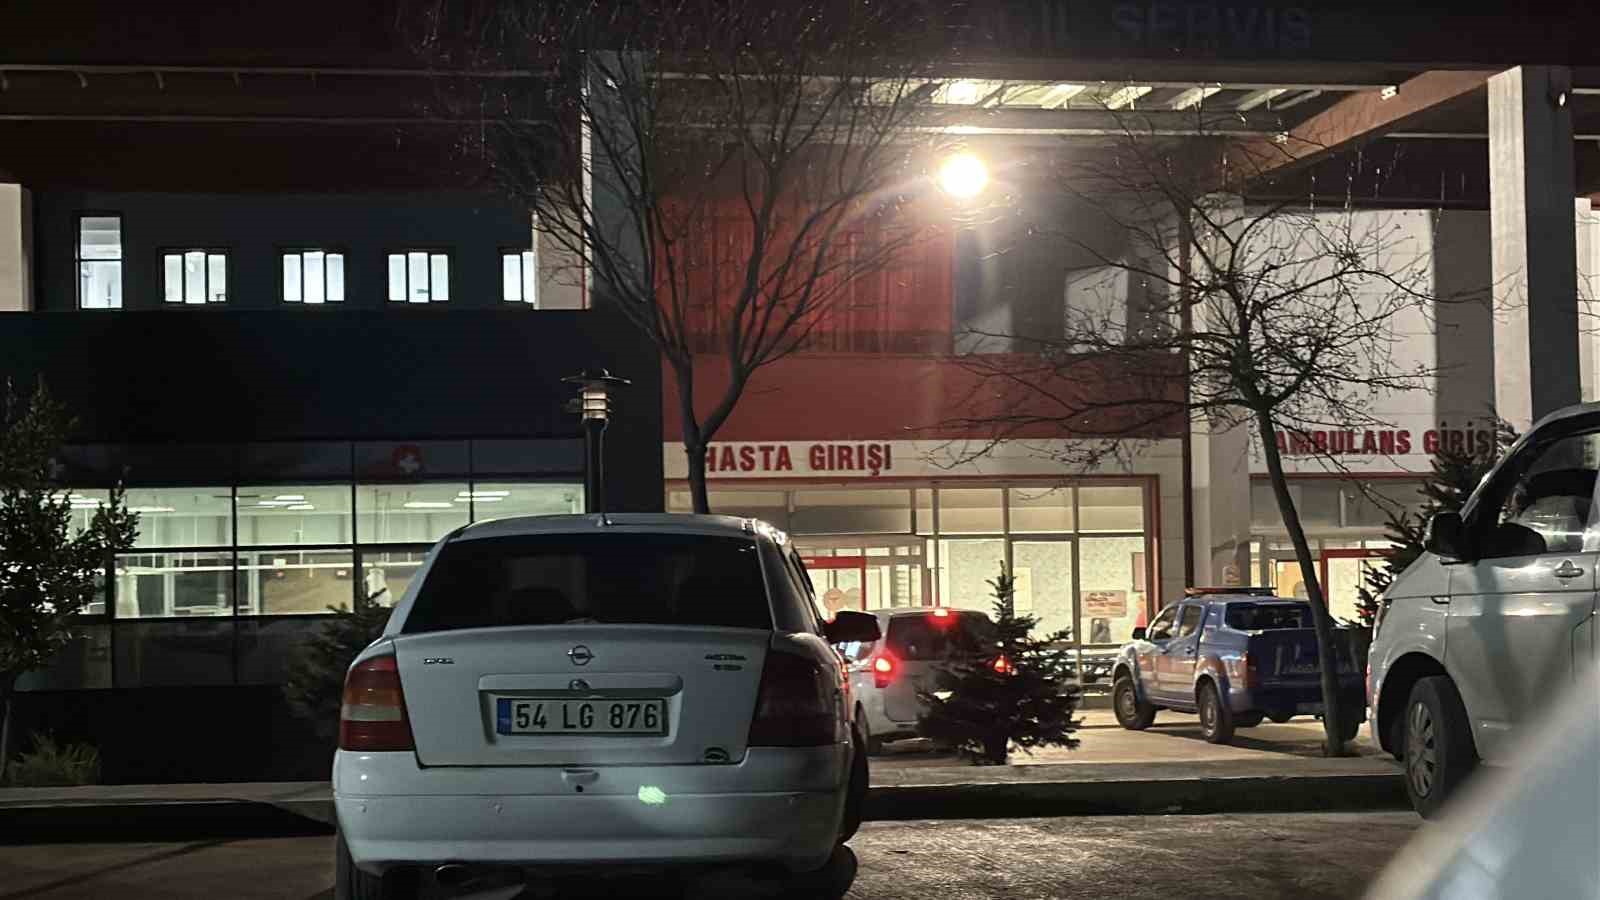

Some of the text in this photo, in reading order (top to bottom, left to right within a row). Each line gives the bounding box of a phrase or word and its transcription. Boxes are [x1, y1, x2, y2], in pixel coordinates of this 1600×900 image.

[1275, 430, 1411, 454] AMBULANS
[706, 445, 792, 471] HASTA
[516, 704, 657, 729] 54 LG 876
